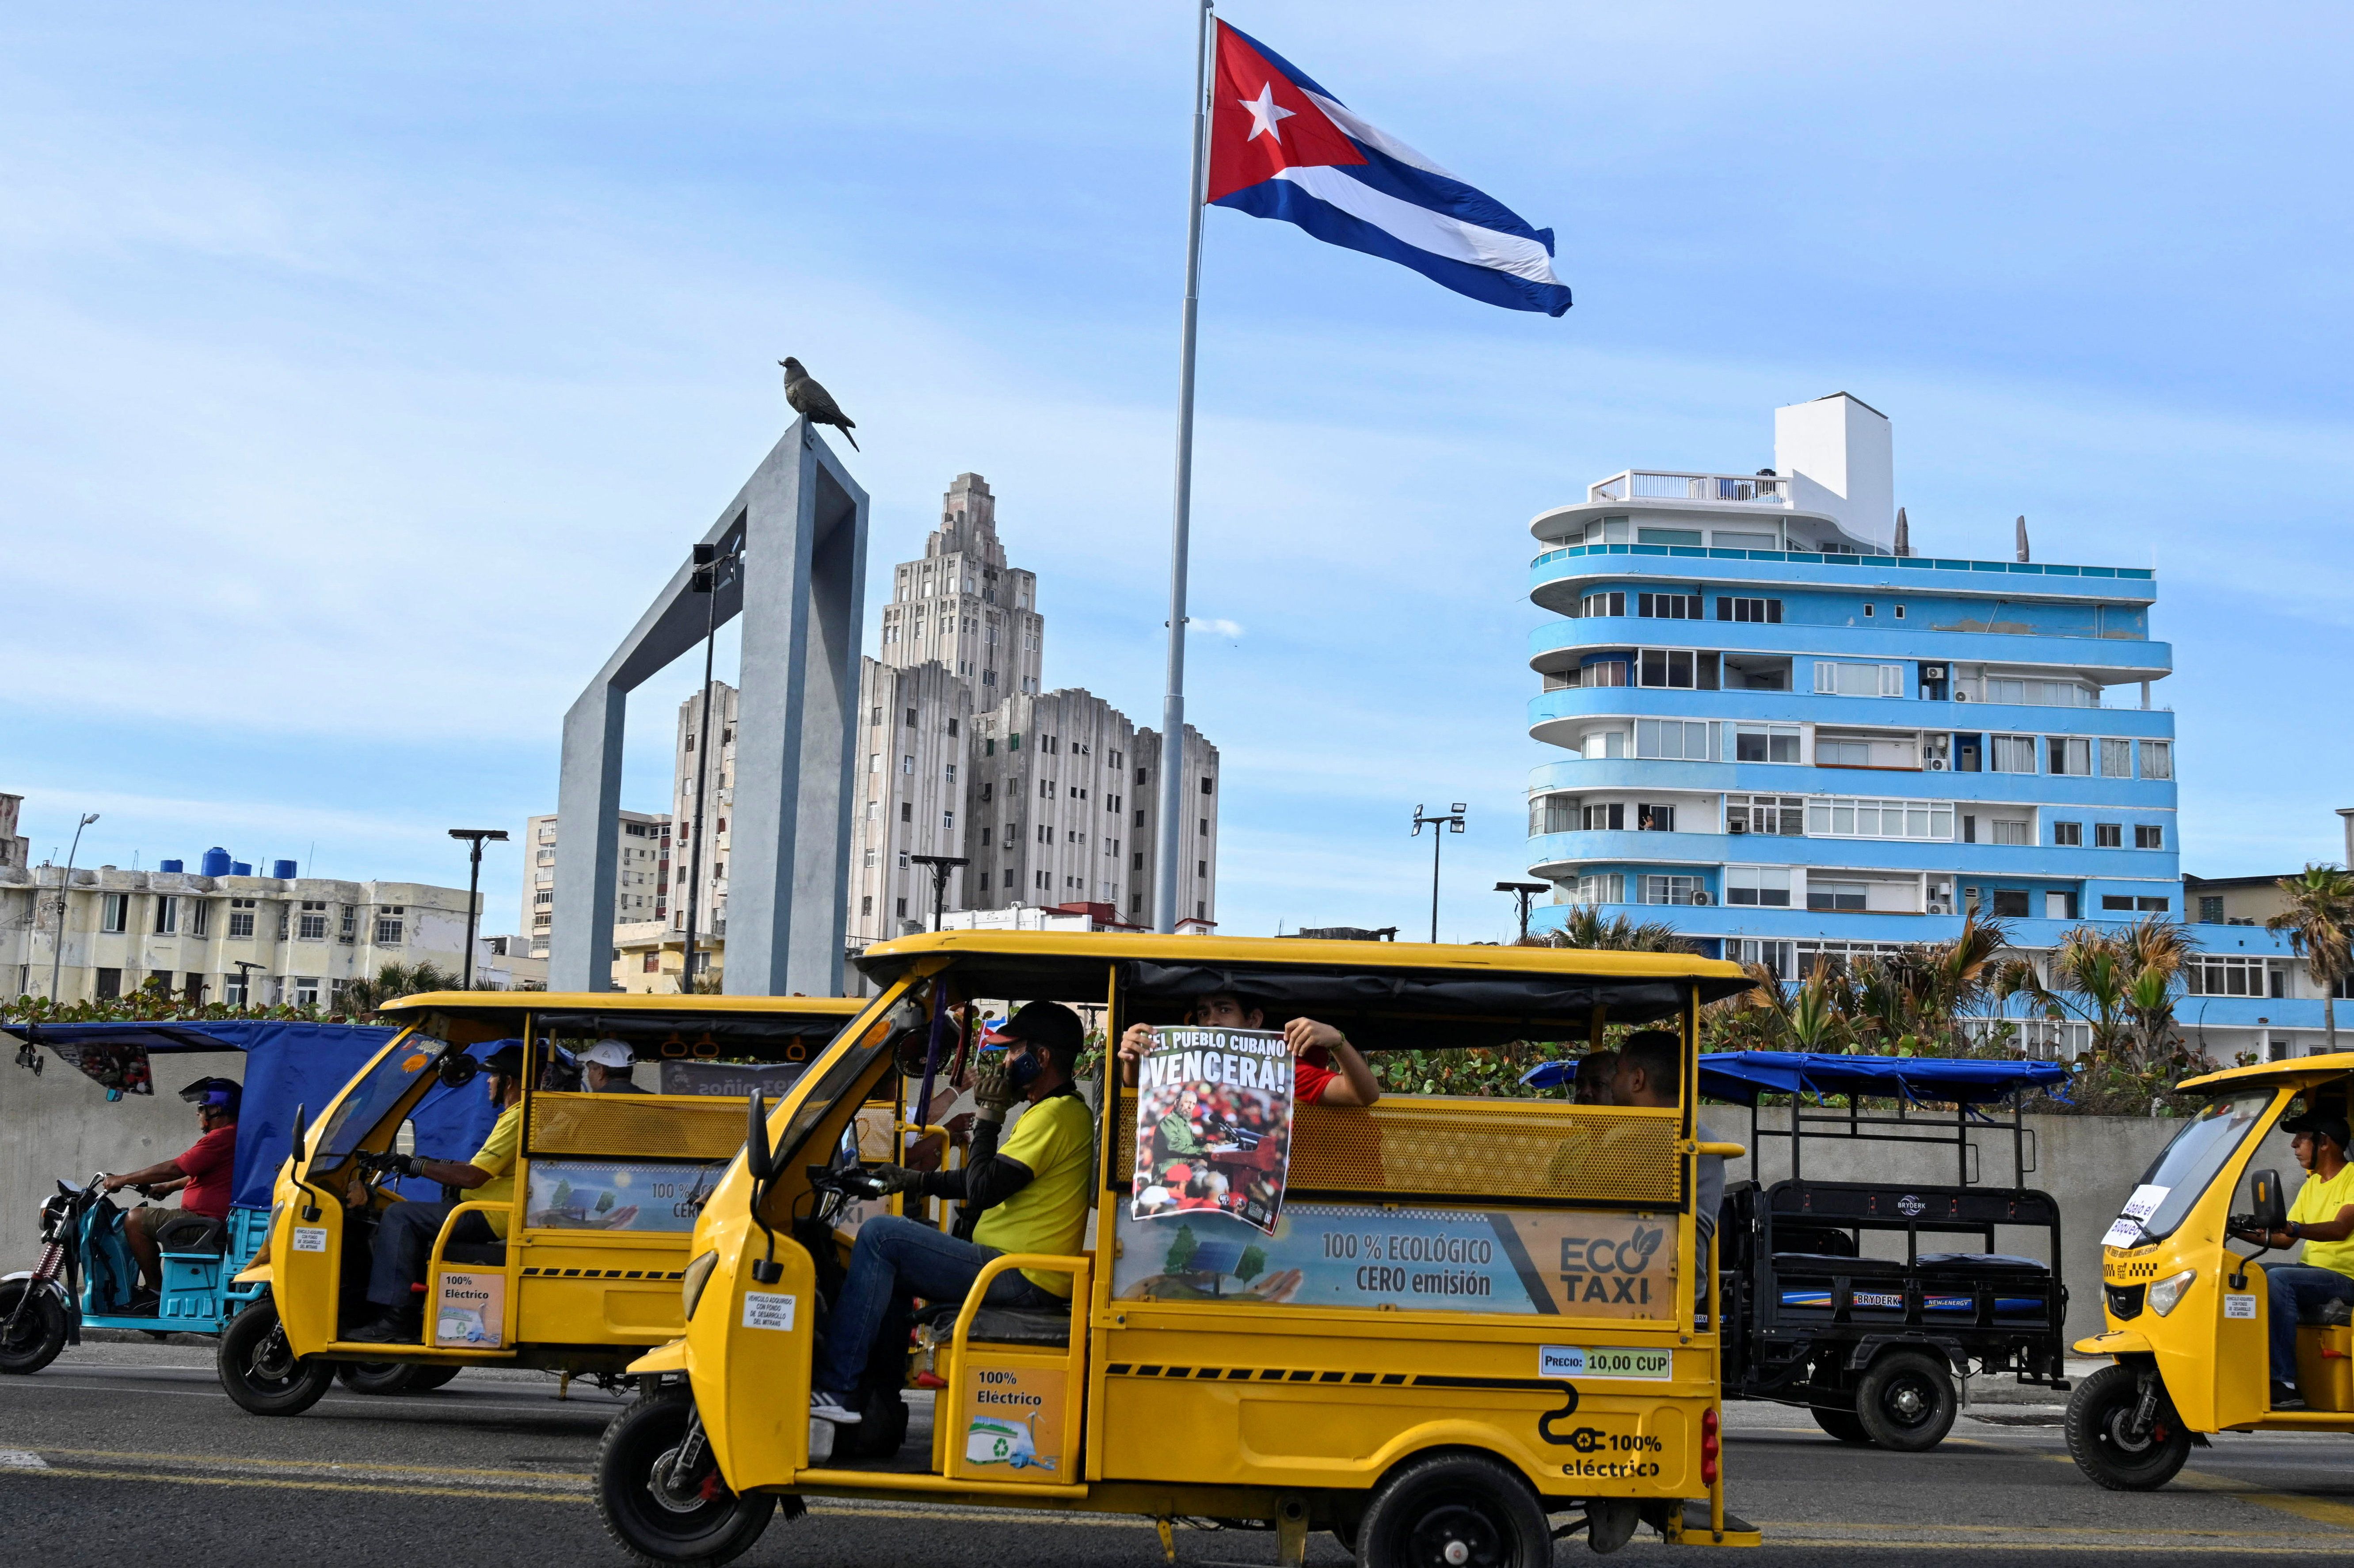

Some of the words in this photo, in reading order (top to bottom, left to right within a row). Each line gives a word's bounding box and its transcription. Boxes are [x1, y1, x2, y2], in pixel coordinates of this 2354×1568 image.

[1173, 1031, 1226, 1049] PUEBLO
[1230, 1035, 1285, 1058] CUBANO
[1149, 1051, 1285, 1093] VENCERÁ!
[652, 1183, 674, 1198] 100
[673, 1203, 701, 1218] CER
[2144, 1203, 2156, 1216] el
[1323, 1233, 1357, 1259] 100
[1364, 1234, 1382, 1260] %
[1388, 1232, 1492, 1264] ECOLÓGICO
[1561, 1237, 1649, 1274] ECO
[446, 1276, 472, 1285] 100%
[1356, 1265, 1406, 1292] CERO
[1412, 1268, 1491, 1296] emisión
[446, 1289, 488, 1299] Eléctrico
[1561, 1275, 1649, 1304] TAXI
[1858, 1294, 1899, 1306] BRYDERK
[758, 1311, 786, 1320] DESARROLLO
[1695, 1315, 1724, 1323] BRYK
[1589, 1355, 1631, 1373] 10,00
[1636, 1356, 1667, 1371] CUP
[979, 1371, 1017, 1385] 100%
[977, 1390, 1042, 1405] Eléctrico
[1609, 1435, 1662, 1452] 100%
[1562, 1459, 1660, 1477] eléctrico
